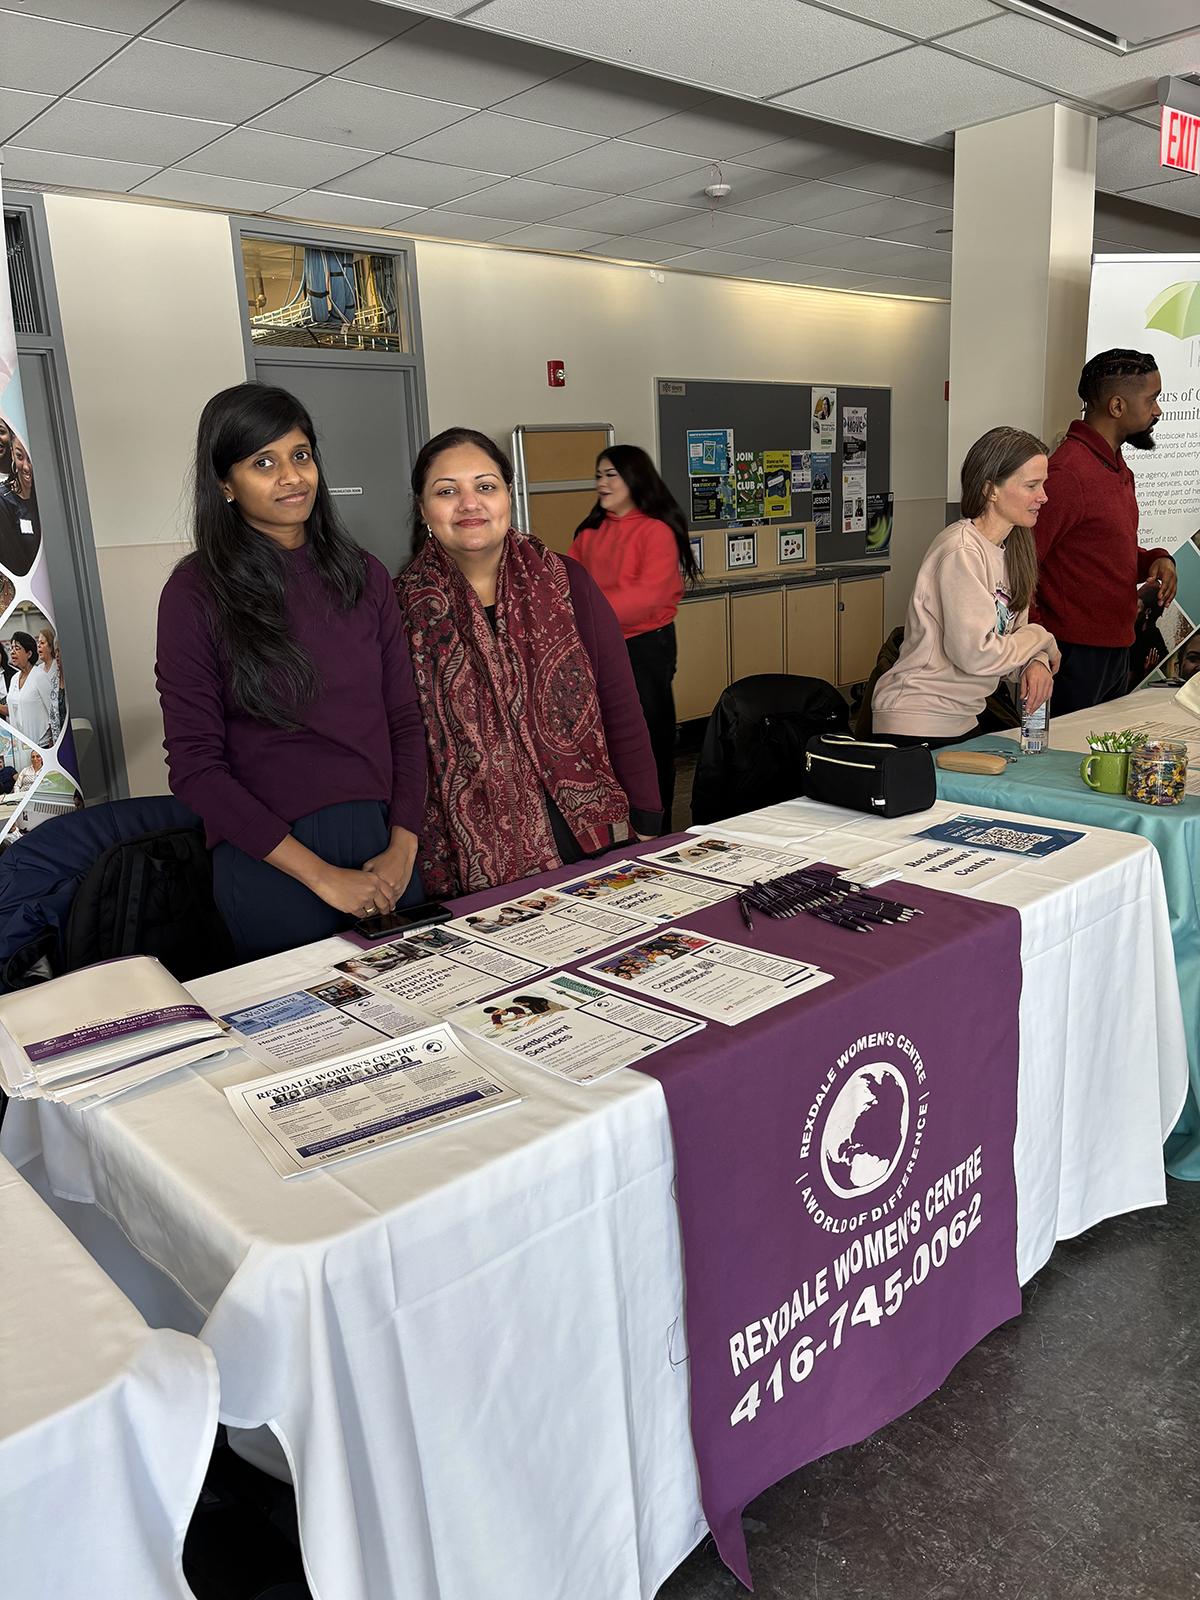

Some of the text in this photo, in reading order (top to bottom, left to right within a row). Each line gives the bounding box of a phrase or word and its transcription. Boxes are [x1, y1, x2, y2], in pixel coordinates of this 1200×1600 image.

[1166, 112, 1200, 170] EXIT
[1159, 391, 1178, 402] ars
[1181, 388, 1194, 401] of
[736, 452, 754, 461] JOIN
[737, 482, 755, 490] CLUB
[904, 846, 954, 868] Rexdale
[924, 849, 980, 873] Women's
[954, 856, 996, 876] Centre
[381, 966, 434, 989] Women's
[389, 964, 460, 994] Employment
[398, 973, 452, 997] Resource
[651, 967, 698, 991] Community
[663, 969, 712, 994] Connections
[405, 982, 445, 1001] Centre
[241, 997, 298, 1019] Wellbeing
[72, 1022, 115, 1038] Rexdale
[115, 1009, 161, 1025] Women's
[258, 1033, 286, 1046] Health
[287, 1028, 303, 1037] and
[514, 1024, 572, 1052] Settlement
[524, 1034, 574, 1058] Services
[256, 1076, 315, 1101] REXDALE
[315, 1056, 372, 1084] WOMEN'S
[372, 1044, 418, 1068] CENTRE
[800, 1031, 926, 1159] REXDALE WOMEN'S CENTRE
[871, 1102, 928, 1222] DIFFERENCE
[729, 1144, 982, 1377] REXDALE WOMEN'S CENTRE
[730, 1192, 982, 1427] 416-745-0062
